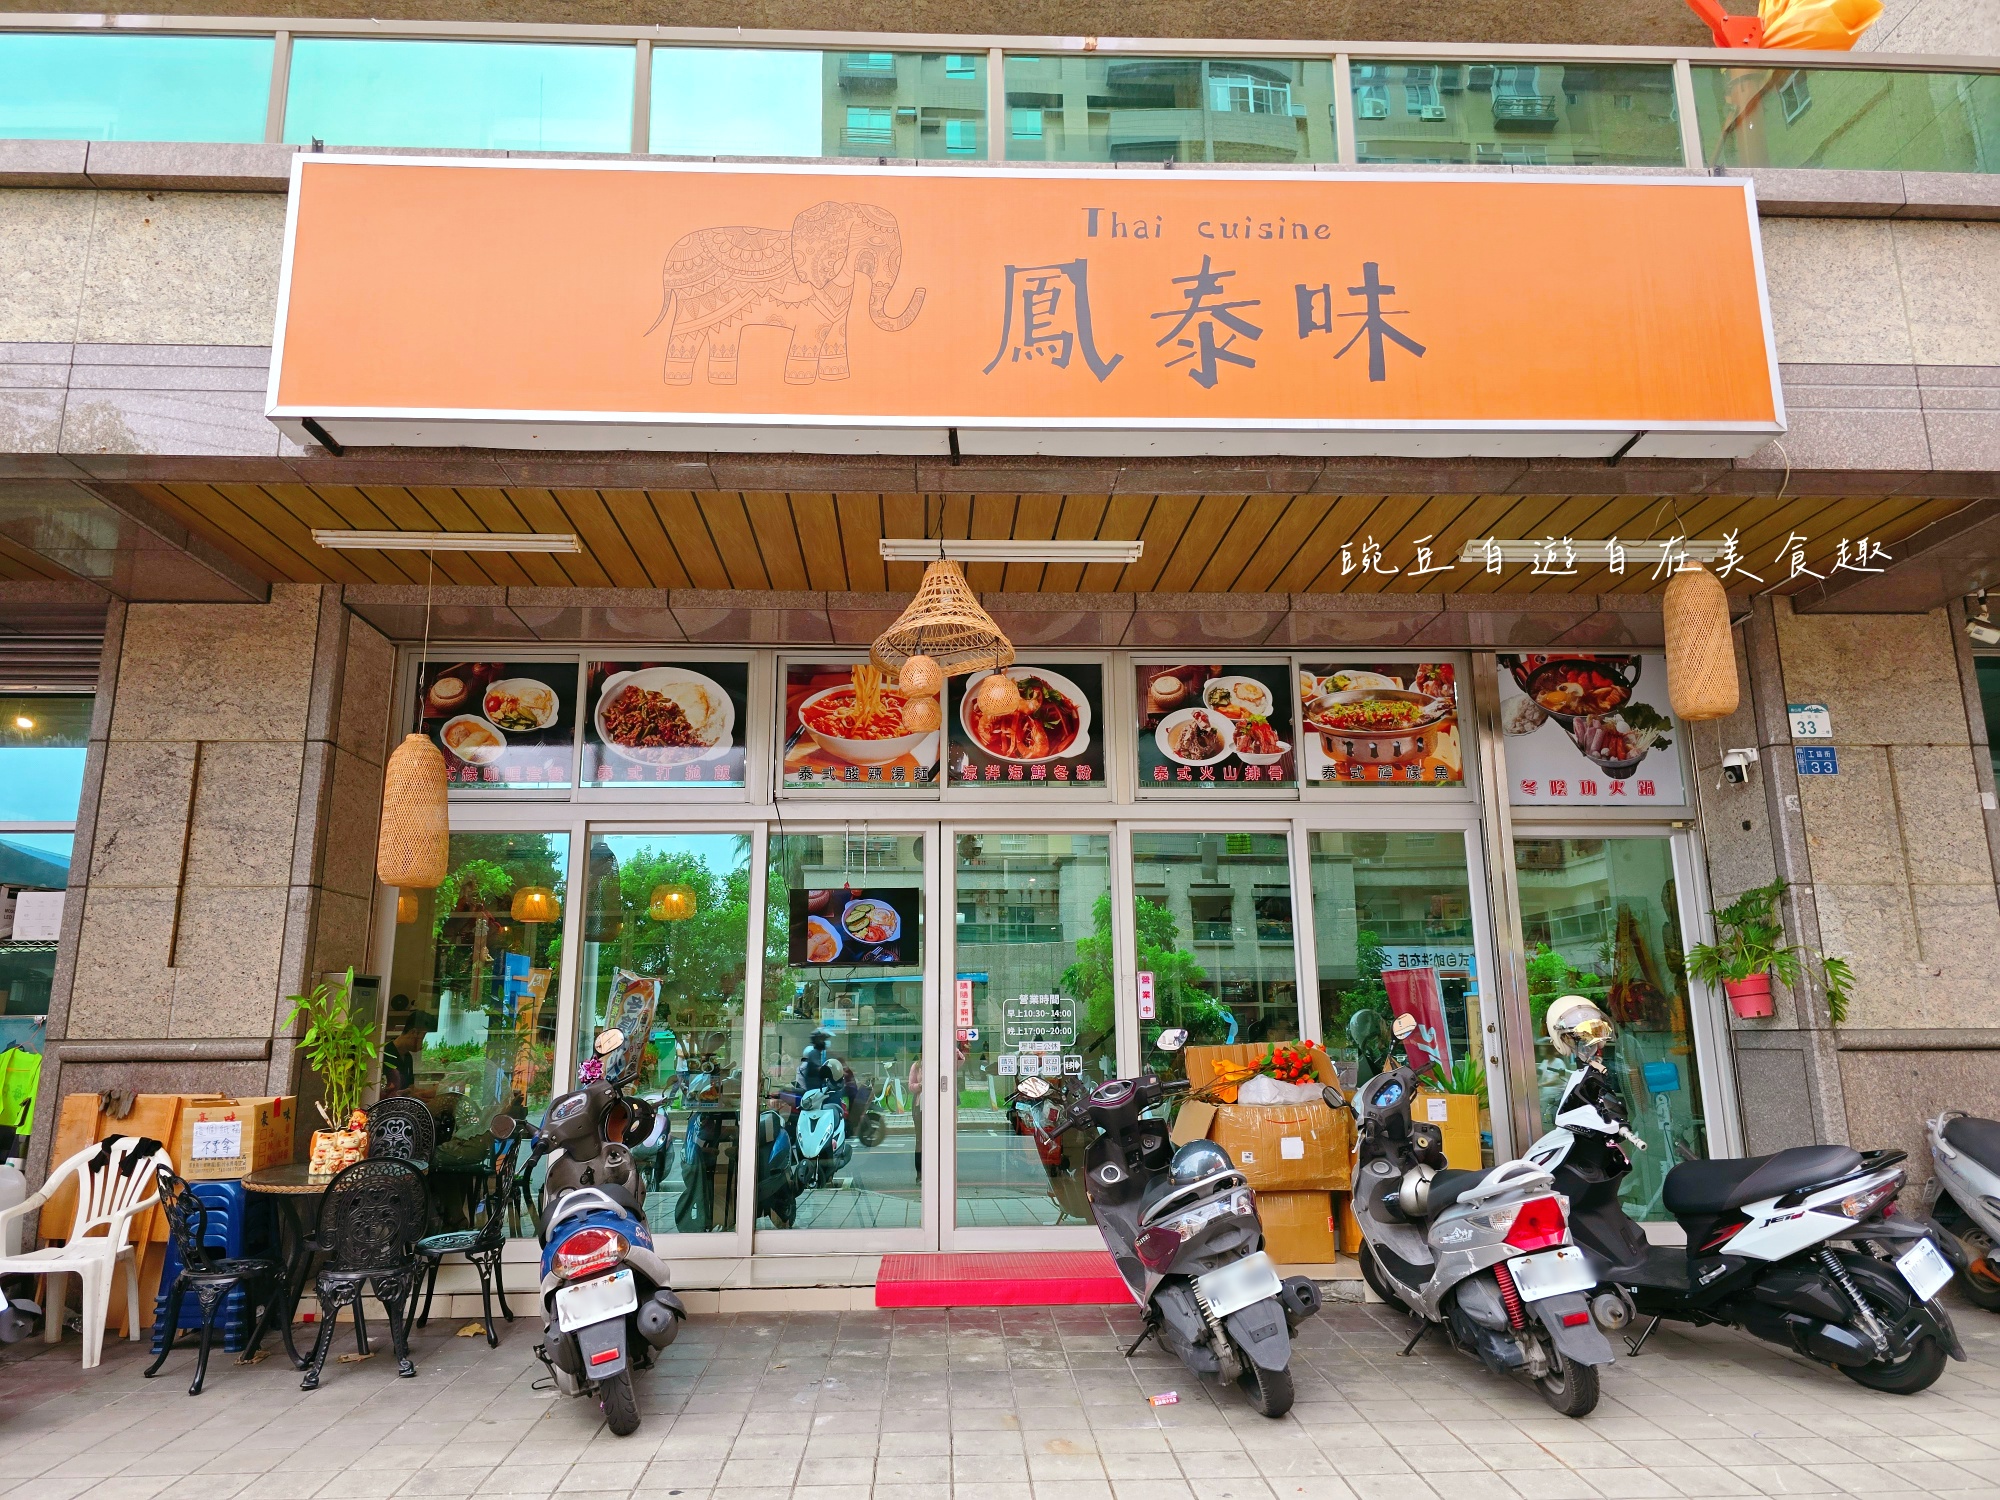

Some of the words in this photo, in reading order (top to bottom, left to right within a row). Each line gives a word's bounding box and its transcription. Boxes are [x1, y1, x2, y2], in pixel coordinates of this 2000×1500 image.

[1081, 207, 1163, 239] Thai
[1198, 216, 1331, 240] cuisine
[982, 254, 1427, 390] 鳳泰味
[1796, 721, 1817, 735] 33
[798, 765, 930, 782] 泰式酸辣湯麵
[962, 765, 1092, 781] 涼拌海鮮冬粉
[1153, 765, 1284, 781] 泰式火山排骨
[1322, 764, 1449, 781] 泰式檸檬魚
[1811, 762, 1833, 774] 33
[1019, 994, 1060, 1005] 營業時間
[1141, 975, 1152, 1015] 營業中
[570, 1250, 611, 1268] SUZUKI
